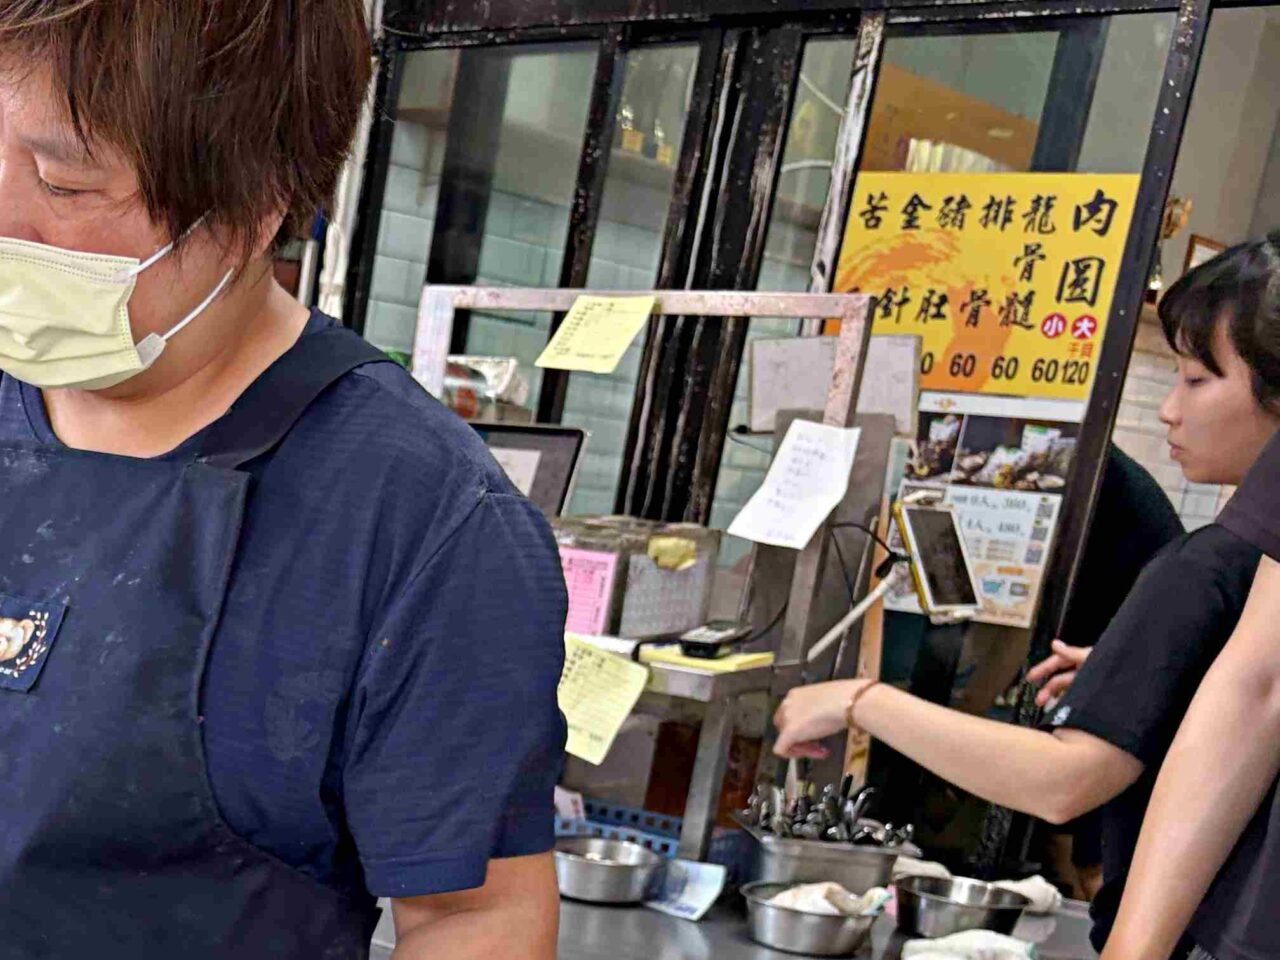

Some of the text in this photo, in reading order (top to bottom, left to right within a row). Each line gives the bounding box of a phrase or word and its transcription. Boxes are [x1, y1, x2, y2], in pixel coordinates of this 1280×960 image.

[1055, 188, 1119, 307] 肉圓
[1042, 313, 1066, 338] 小
[1072, 316, 1096, 338] 大
[949, 354, 976, 378] 60
[991, 356, 1018, 380] 60
[1031, 358, 1059, 383] 60
[1061, 360, 1090, 385] 120
